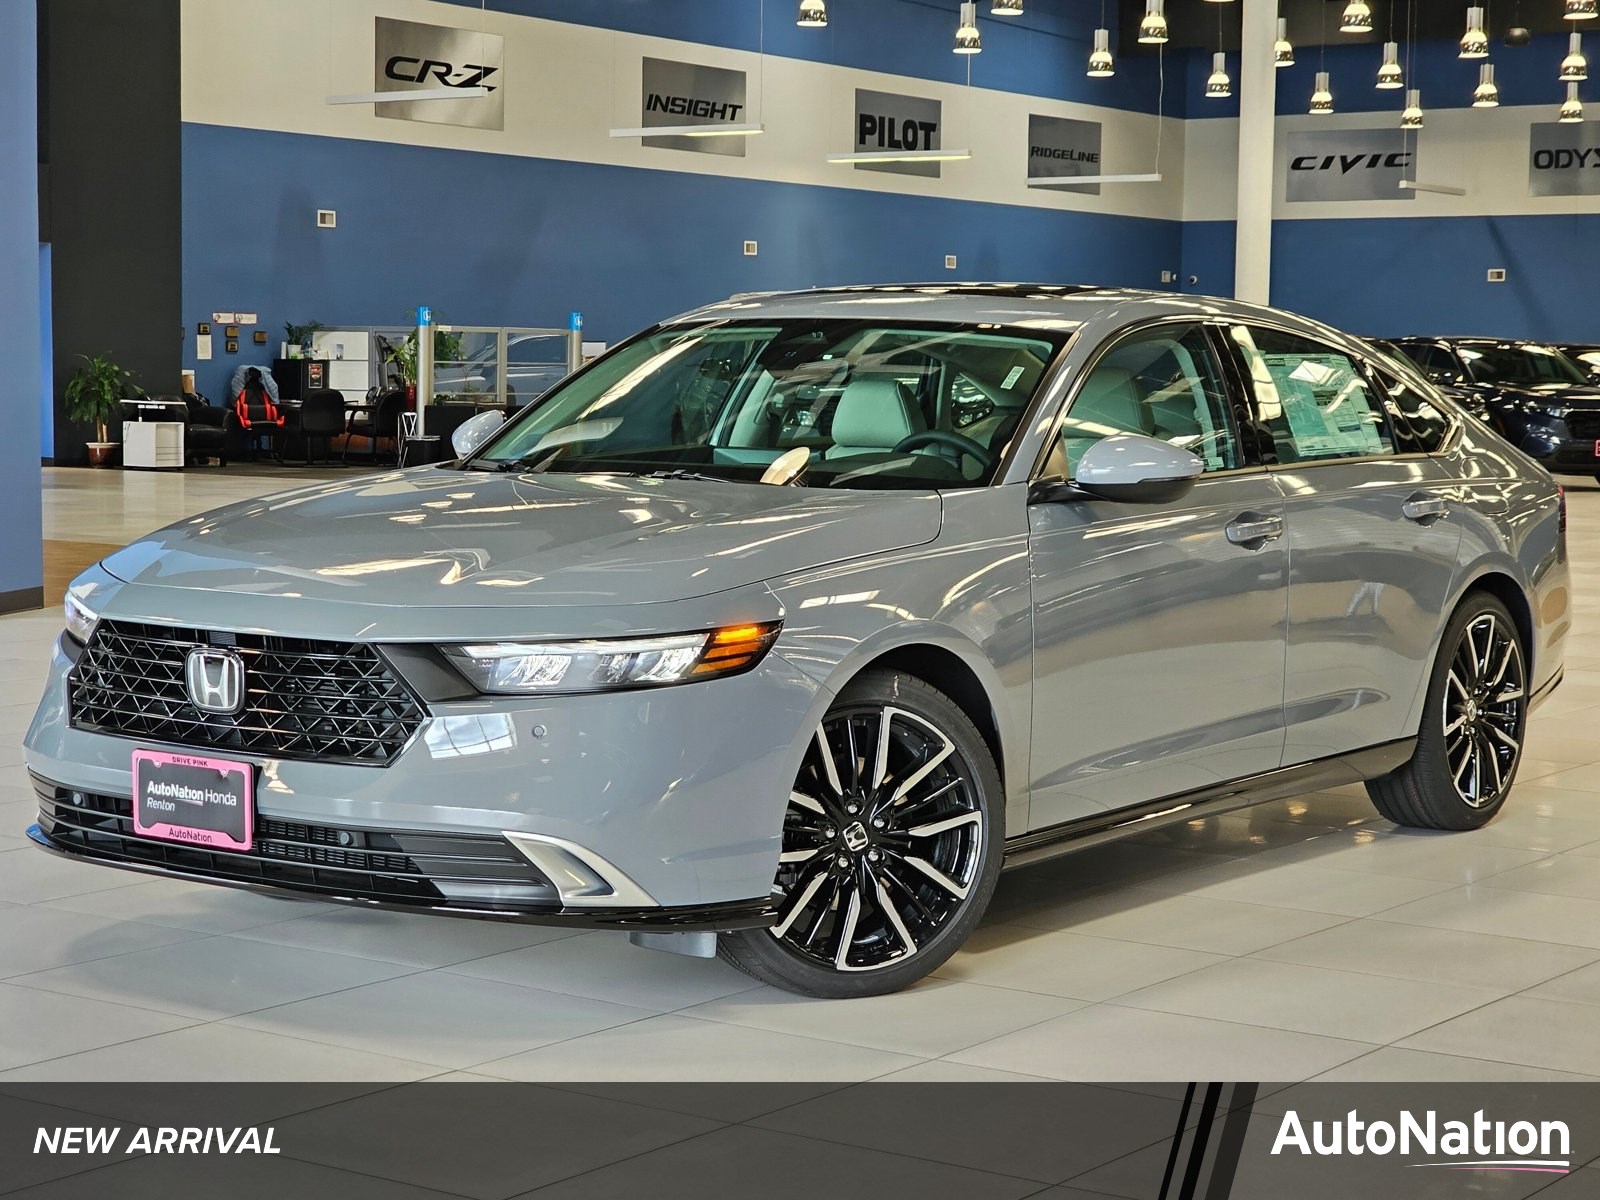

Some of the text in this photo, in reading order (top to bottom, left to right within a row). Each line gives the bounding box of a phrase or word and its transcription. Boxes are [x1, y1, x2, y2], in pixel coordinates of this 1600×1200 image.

[385, 56, 498, 91] CR-Z
[646, 94, 743, 121] INSIGHT
[859, 113, 937, 151] PILOT
[1030, 146, 1100, 163] RIDGELINE
[1290, 152, 1412, 175] CIVIC
[172, 756, 208, 767] DRIVE PINK
[147, 780, 237, 806] AutoNation Honda
[147, 797, 175, 812] Renton
[168, 827, 213, 843] AutoNation
